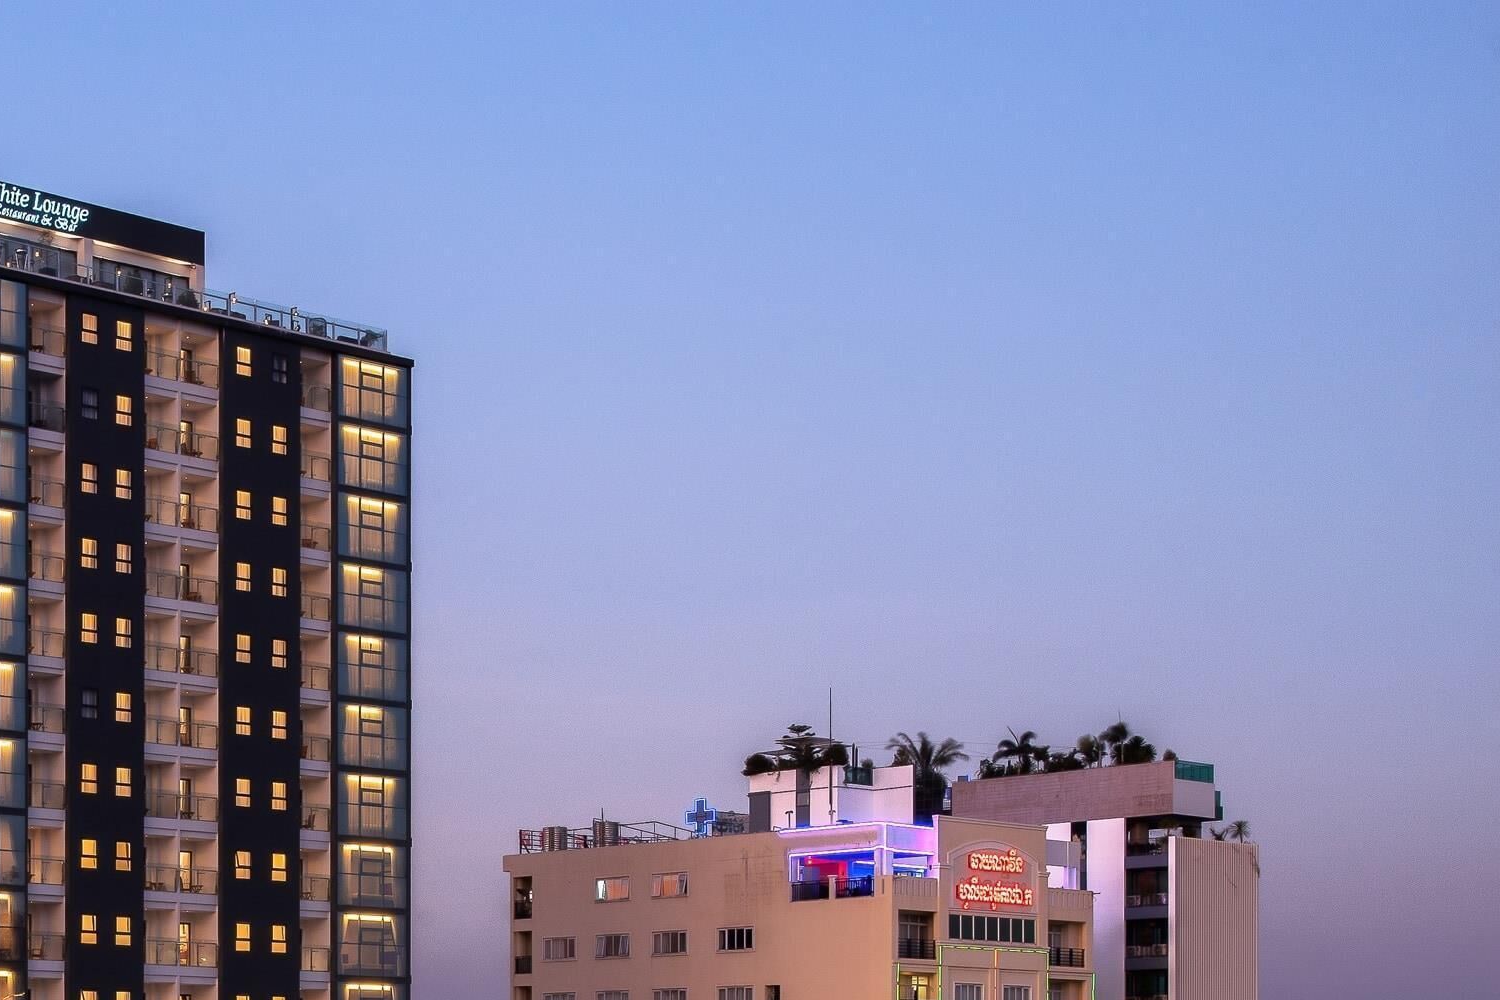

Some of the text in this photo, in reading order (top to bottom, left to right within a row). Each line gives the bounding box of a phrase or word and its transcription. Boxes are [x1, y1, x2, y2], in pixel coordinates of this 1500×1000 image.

[33, 192, 90, 224] Lounge
[41, 214, 53, 226] &
[54, 217, 78, 232] Bar
